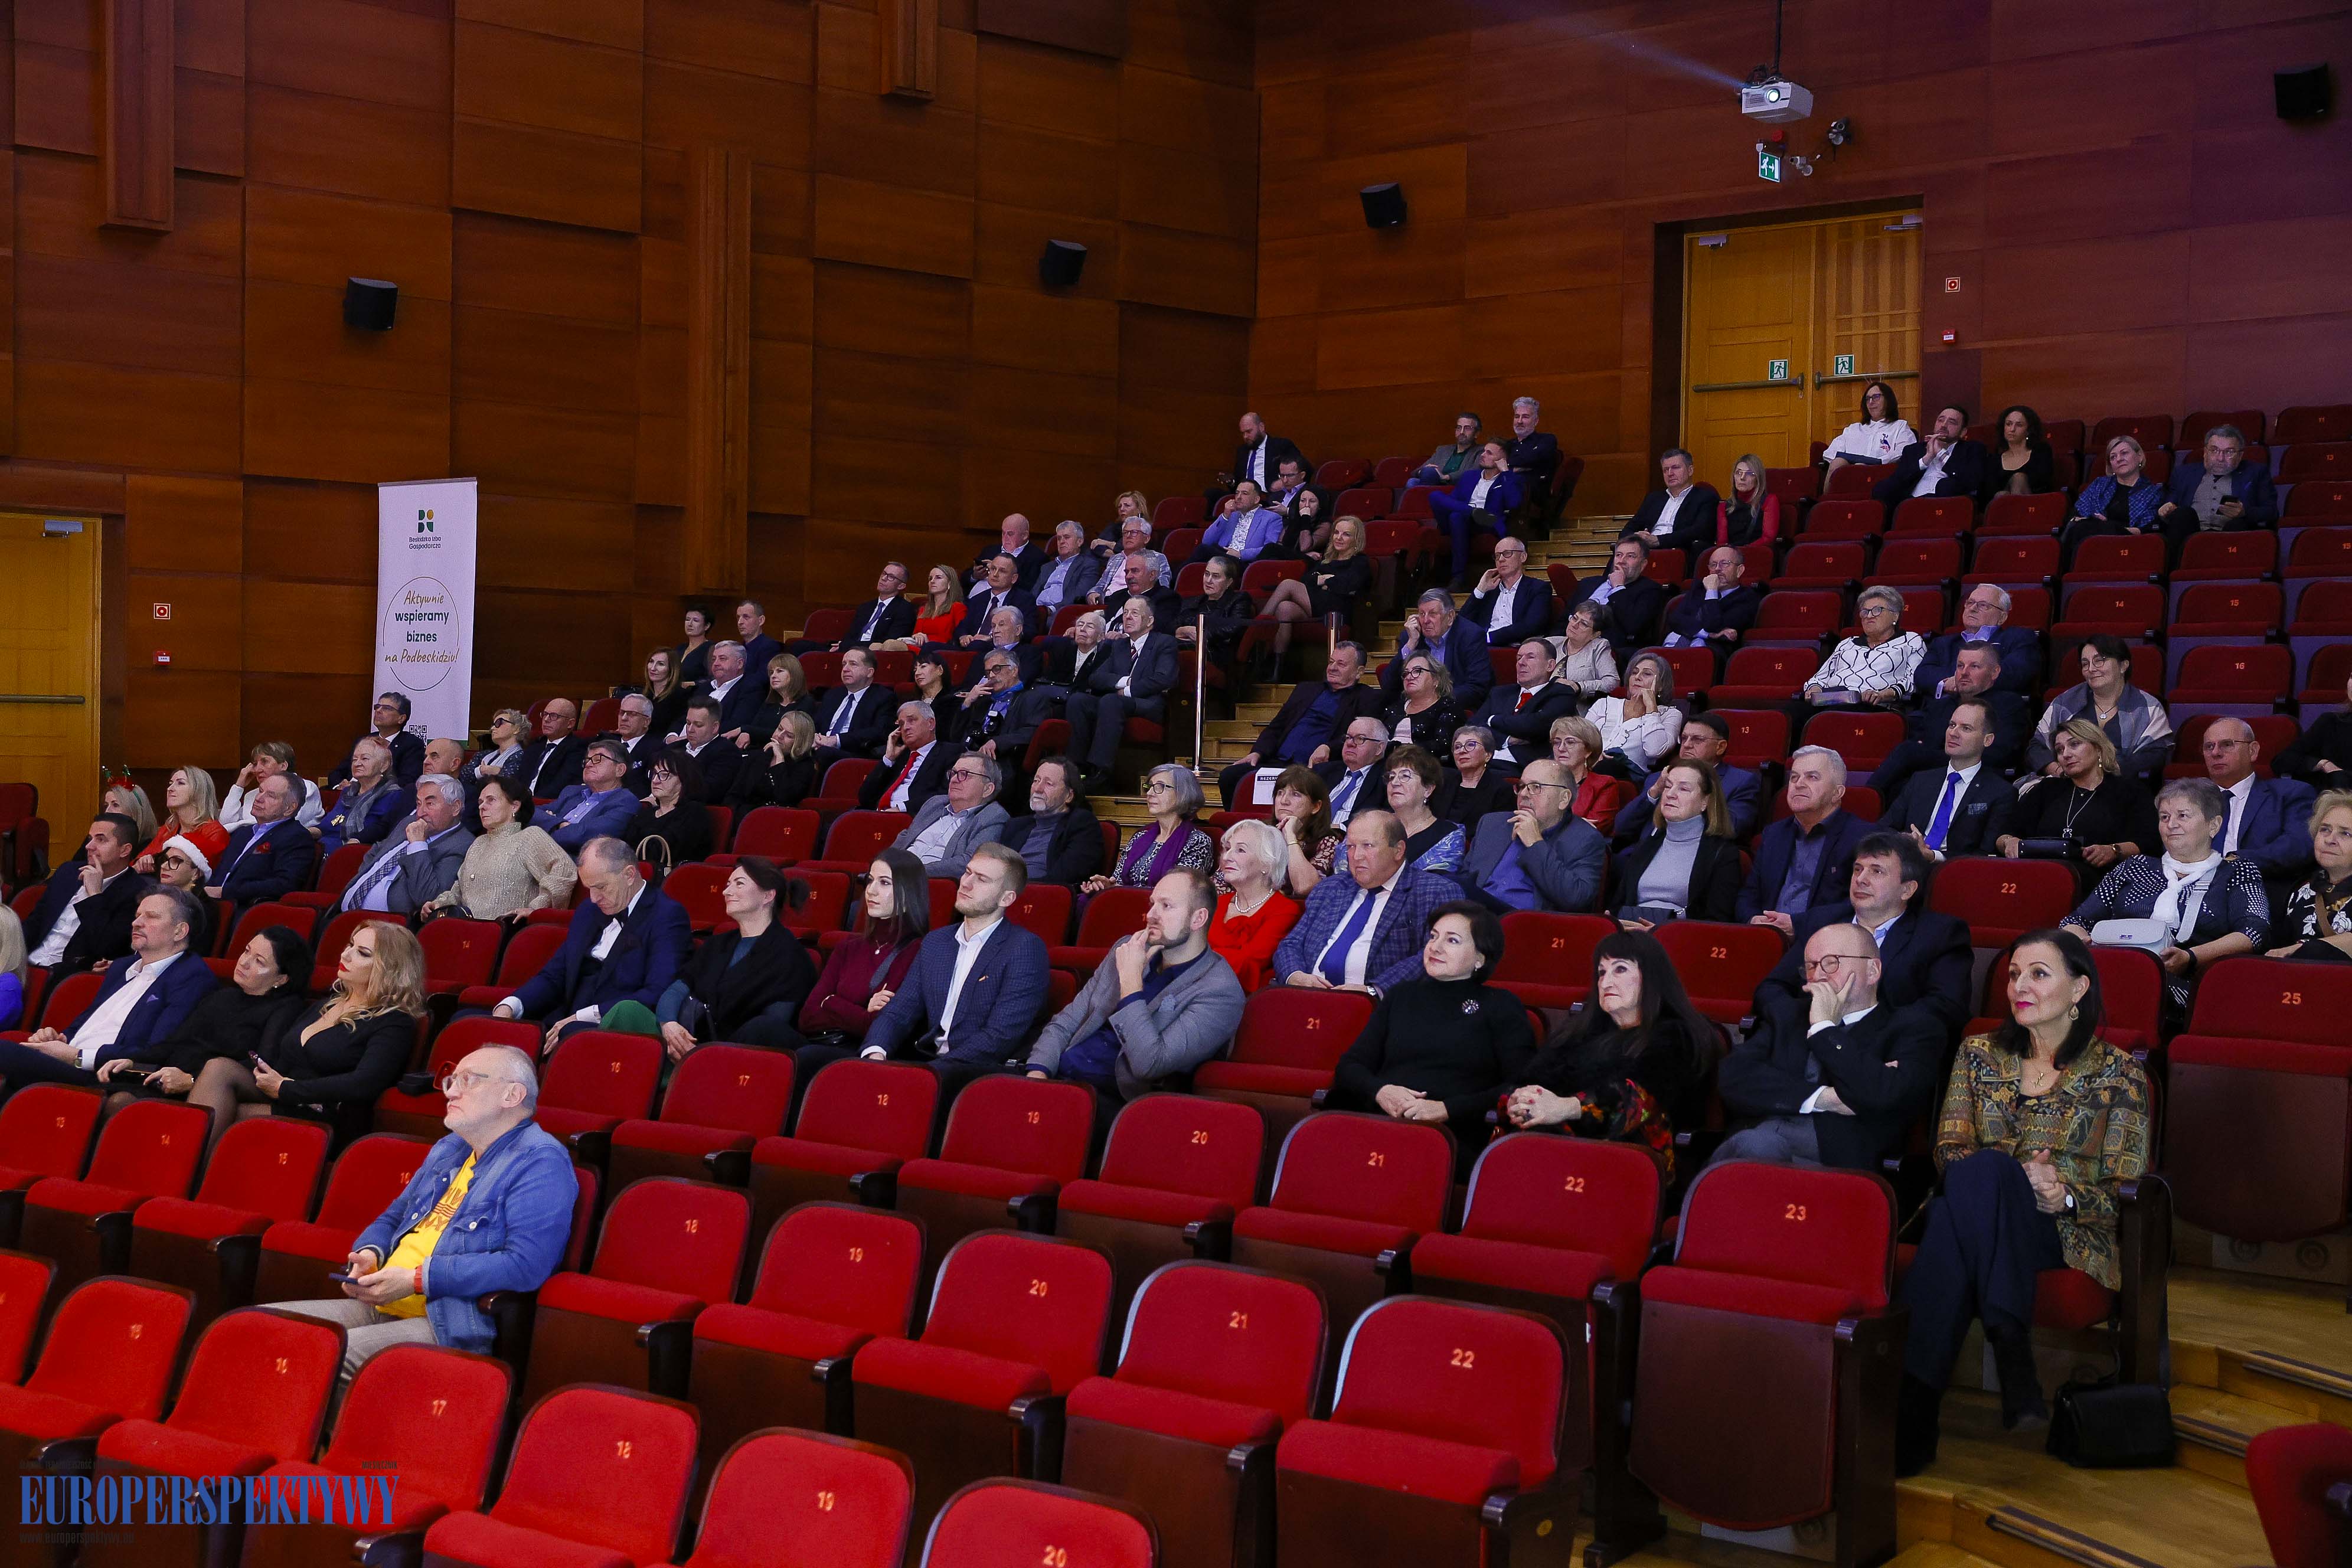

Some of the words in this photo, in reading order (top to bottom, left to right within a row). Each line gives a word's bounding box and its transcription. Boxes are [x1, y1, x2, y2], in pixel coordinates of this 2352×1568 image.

[409, 543, 441, 551] Gospodarcza
[404, 590, 445, 609] Aktywnie
[395, 609, 449, 625] wspieramy
[406, 630, 437, 642] biznes
[400, 648, 460, 664] Podbeskidziu!
[2001, 883, 2017, 893] 22
[1024, 904, 1033, 913] 17
[1551, 937, 1565, 949] 21
[1710, 947, 1727, 958] 22
[2282, 992, 2301, 1005] 25
[1306, 1018, 1320, 1030] 21
[739, 1075, 750, 1086] 17
[878, 1095, 888, 1105] 18
[1028, 1111, 1040, 1123] 19
[1191, 1131, 1208, 1144] 20
[1368, 1152, 1384, 1167] 21
[1565, 1177, 1585, 1193] 22
[1785, 1204, 1807, 1220] 23
[850, 1247, 863, 1262] 19
[1030, 1279, 1047, 1297] 20
[1229, 1311, 1248, 1329] 21
[1451, 1348, 1475, 1368] 22
[433, 1400, 447, 1416] 17
[1043, 1545, 1067, 1568] 20
